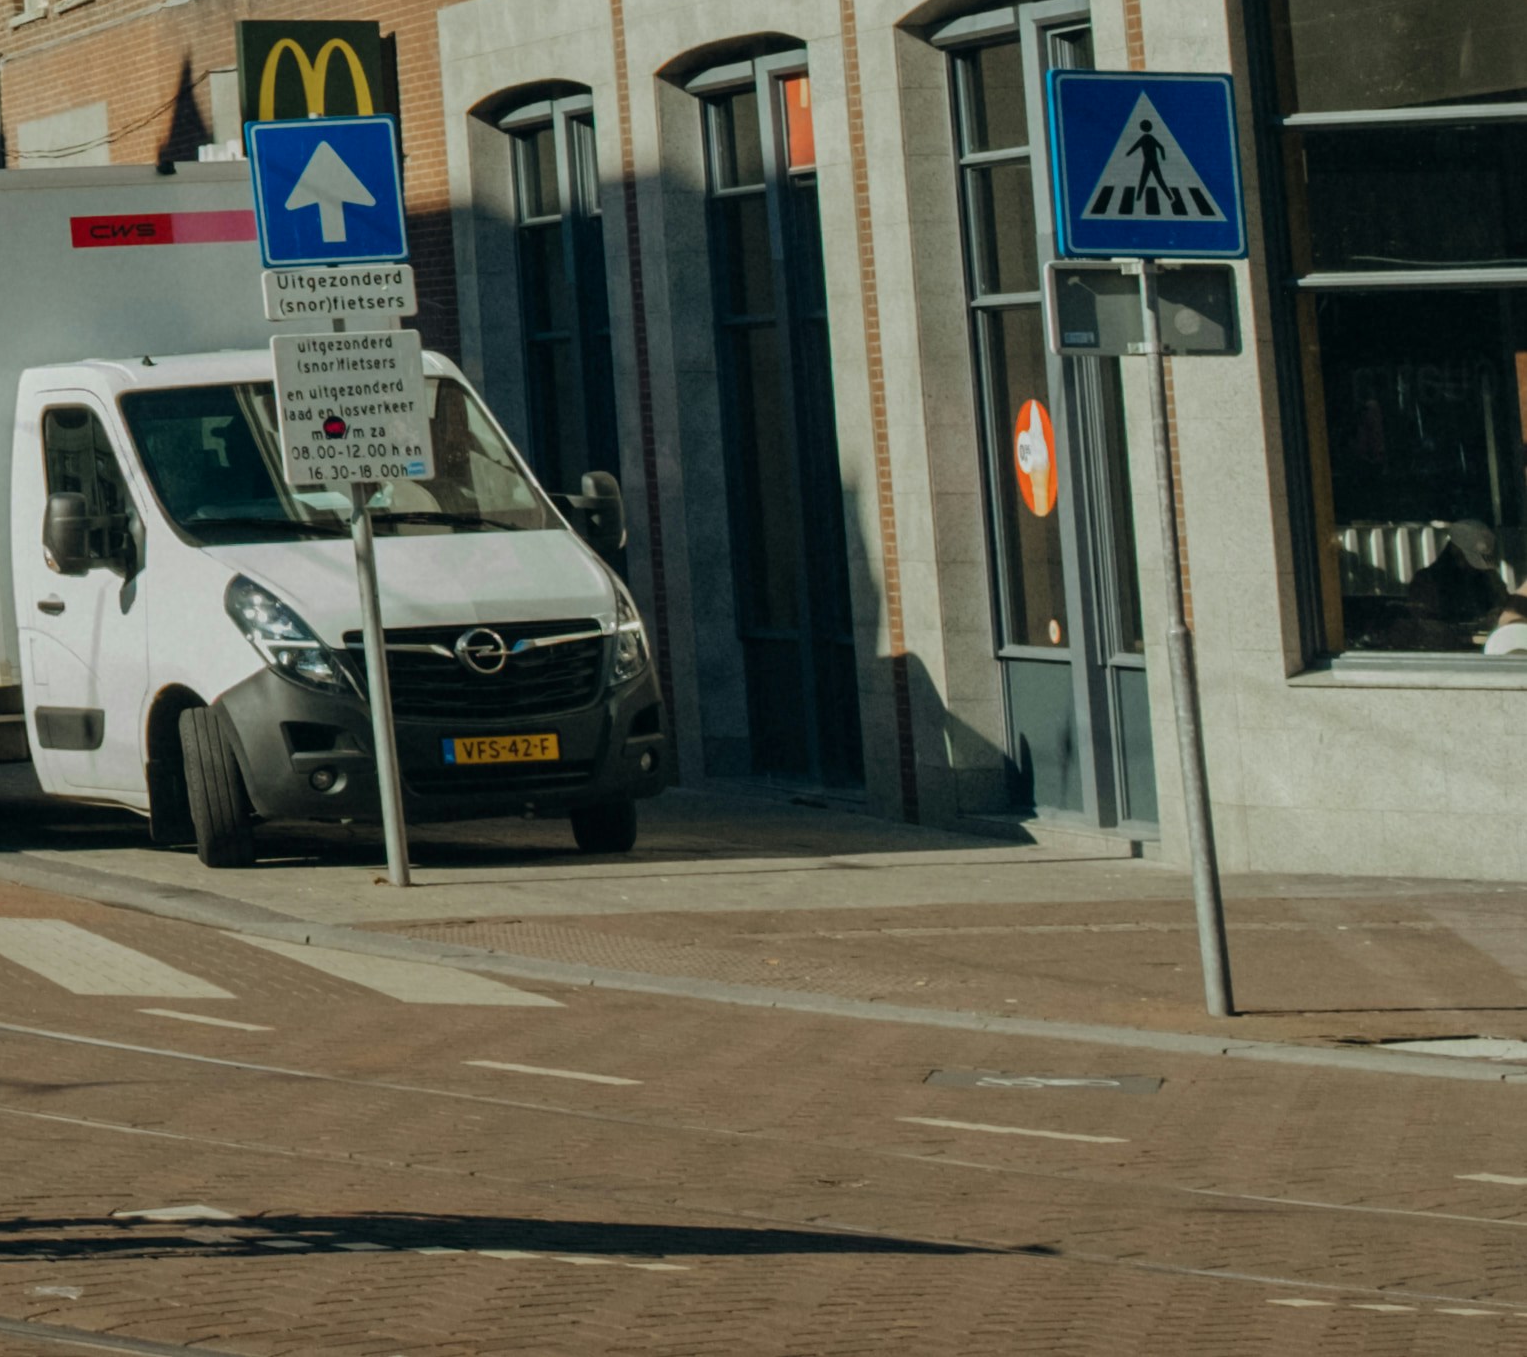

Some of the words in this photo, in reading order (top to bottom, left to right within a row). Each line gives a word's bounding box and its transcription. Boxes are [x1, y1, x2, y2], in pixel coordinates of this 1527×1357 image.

[90, 222, 156, 239] CWS
[277, 270, 403, 293] Uitgezonderd
[279, 295, 405, 316] (snor)fietsers
[297, 336, 393, 356] uitgezonderd
[297, 357, 396, 374] (snor)fietsers
[287, 389, 304, 401] en
[309, 378, 404, 402] uitgezonderd
[284, 407, 313, 422] laad
[339, 400, 415, 418] losverkeer
[311, 429, 331, 440] m
[371, 426, 386, 437] za
[391, 444, 400, 456] h
[405, 445, 422, 456] en
[462, 738, 550, 759] VFS-42-F
